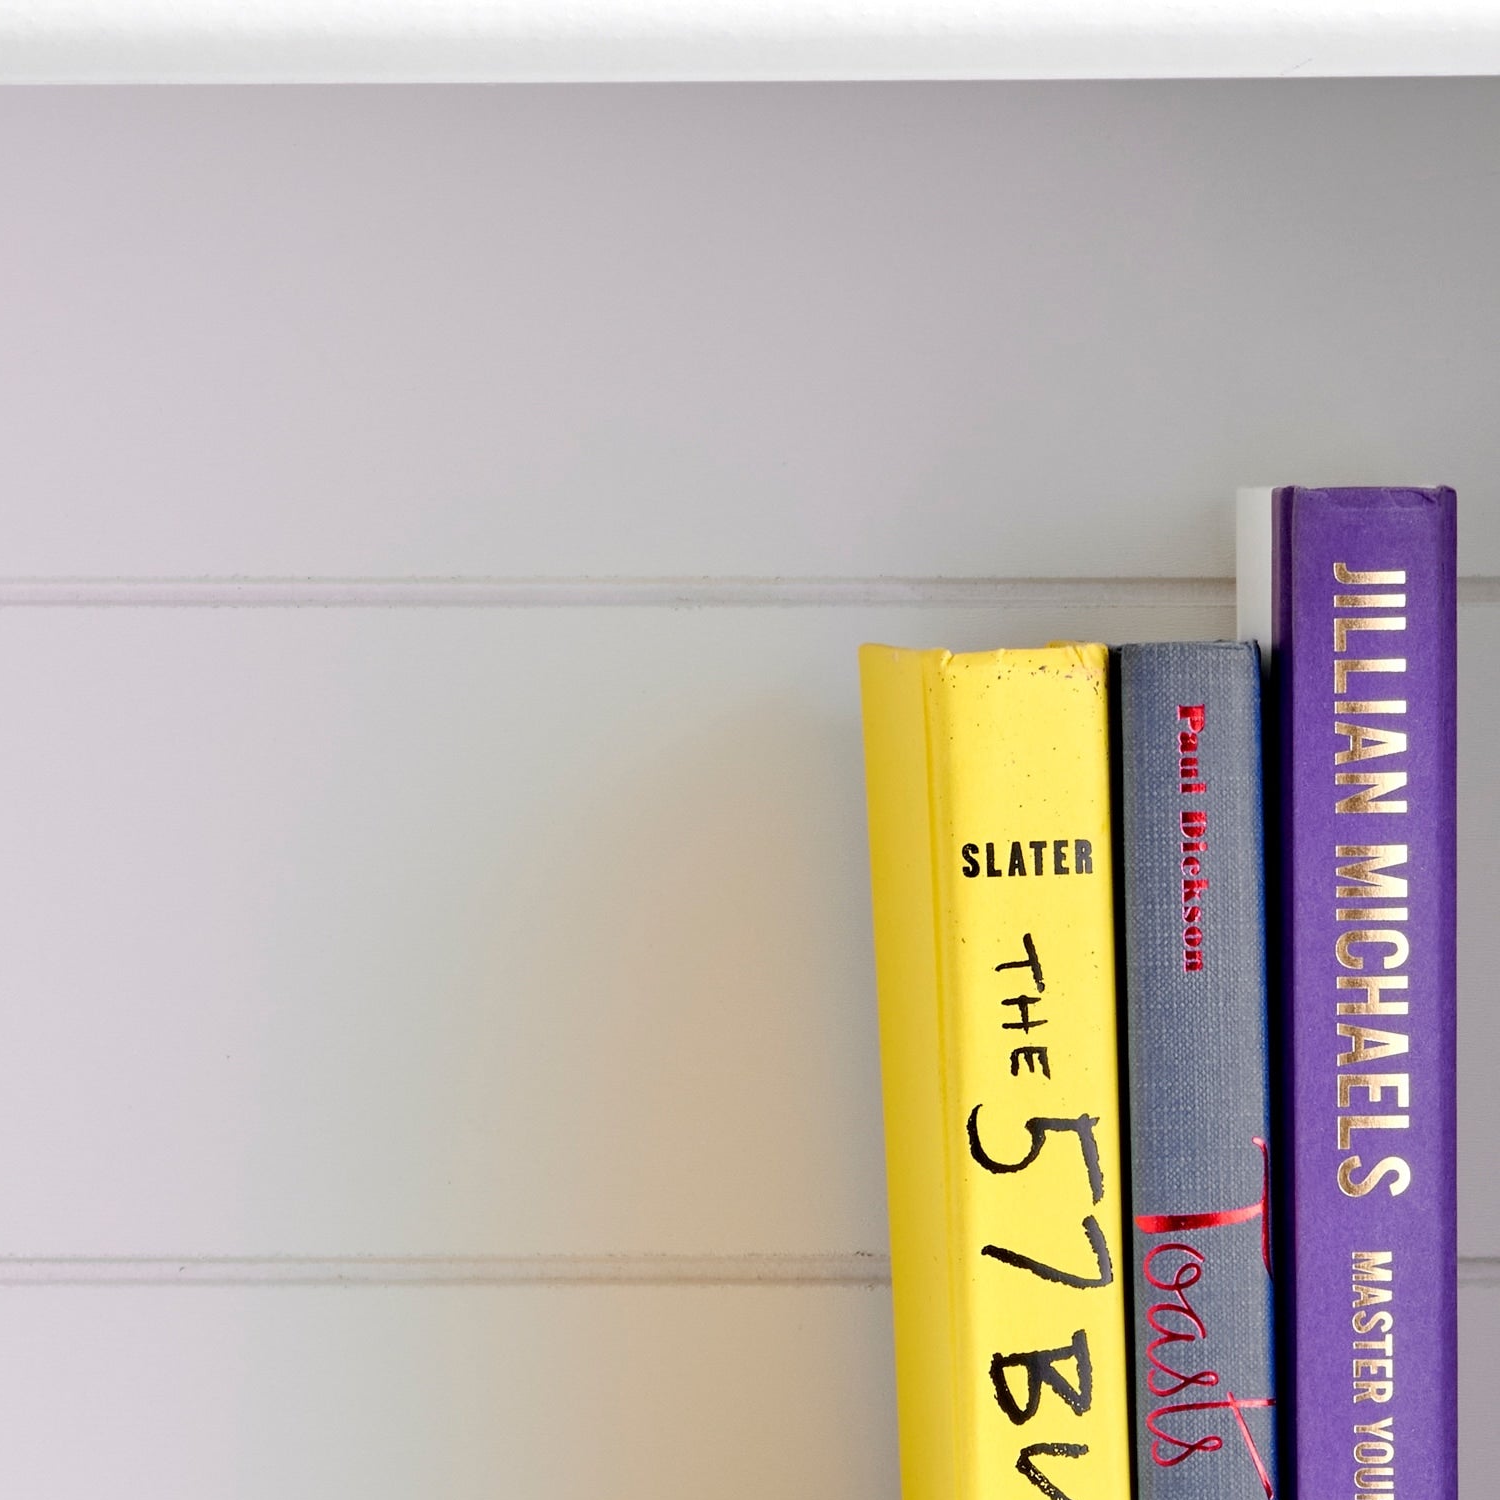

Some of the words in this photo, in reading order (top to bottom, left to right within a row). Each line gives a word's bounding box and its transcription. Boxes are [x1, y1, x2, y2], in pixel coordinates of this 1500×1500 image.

[1176, 704, 1208, 795] Paul
[1332, 561, 1408, 814] JILLIAN
[960, 838, 1094, 878] SLATER
[1179, 810, 1210, 973] Dickson
[993, 932, 1052, 1080] THE
[1333, 843, 1413, 1199] MICHAELS
[966, 1103, 1114, 1290] 57
[1350, 1250, 1395, 1404] MASTER
